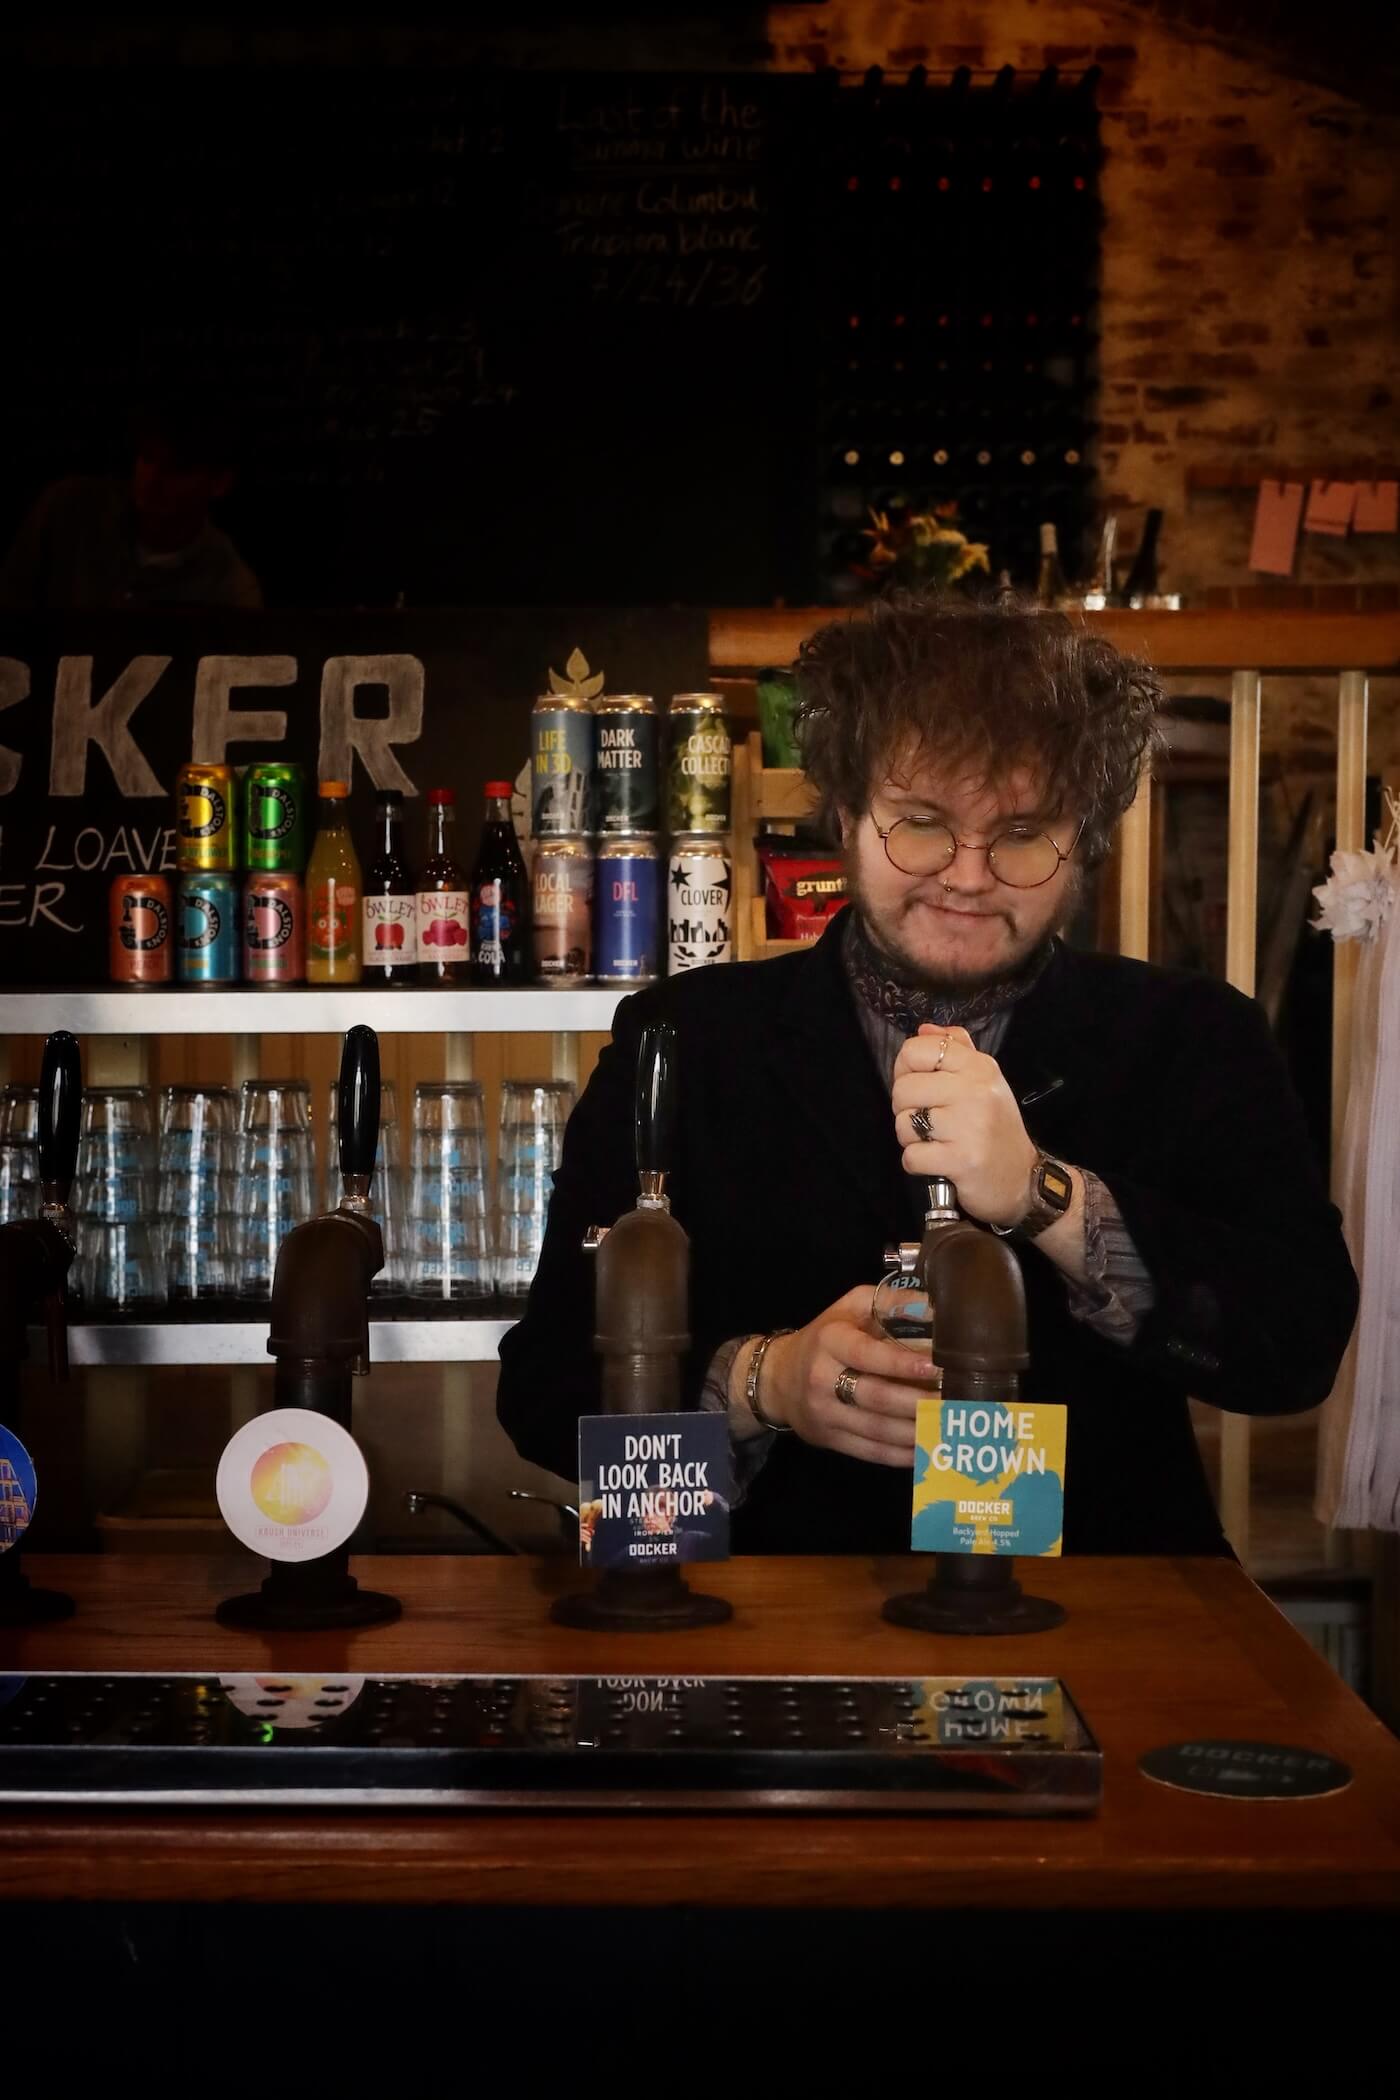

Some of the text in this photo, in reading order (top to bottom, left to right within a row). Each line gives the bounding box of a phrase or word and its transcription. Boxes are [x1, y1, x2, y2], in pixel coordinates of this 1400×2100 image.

[555, 85, 765, 134] Last of the
[539, 730, 566, 751] LIFE
[601, 729, 635, 748] DARK
[688, 735, 731, 754] CASCAD
[536, 752, 571, 774] IN 3D
[597, 750, 642, 769] MATTER
[681, 756, 731, 775] COLLECT
[35, 824, 176, 871] LOAVE
[536, 873, 573, 892] LOCAL
[612, 882, 639, 902] DFL
[535, 894, 574, 913] LAGER
[681, 889, 723, 906] CLOVER
[947, 1409, 1034, 1440] HOME
[625, 1434, 682, 1461] DON'T
[932, 1443, 1046, 1475] GROWN
[599, 1462, 709, 1491] LOOK BACK
[602, 1491, 706, 1519] IN ANCHOR
[958, 1501, 1011, 1515] DOCKER
[629, 1543, 678, 1557] DOCKER
[1178, 1744, 1331, 1769] DOCKER
